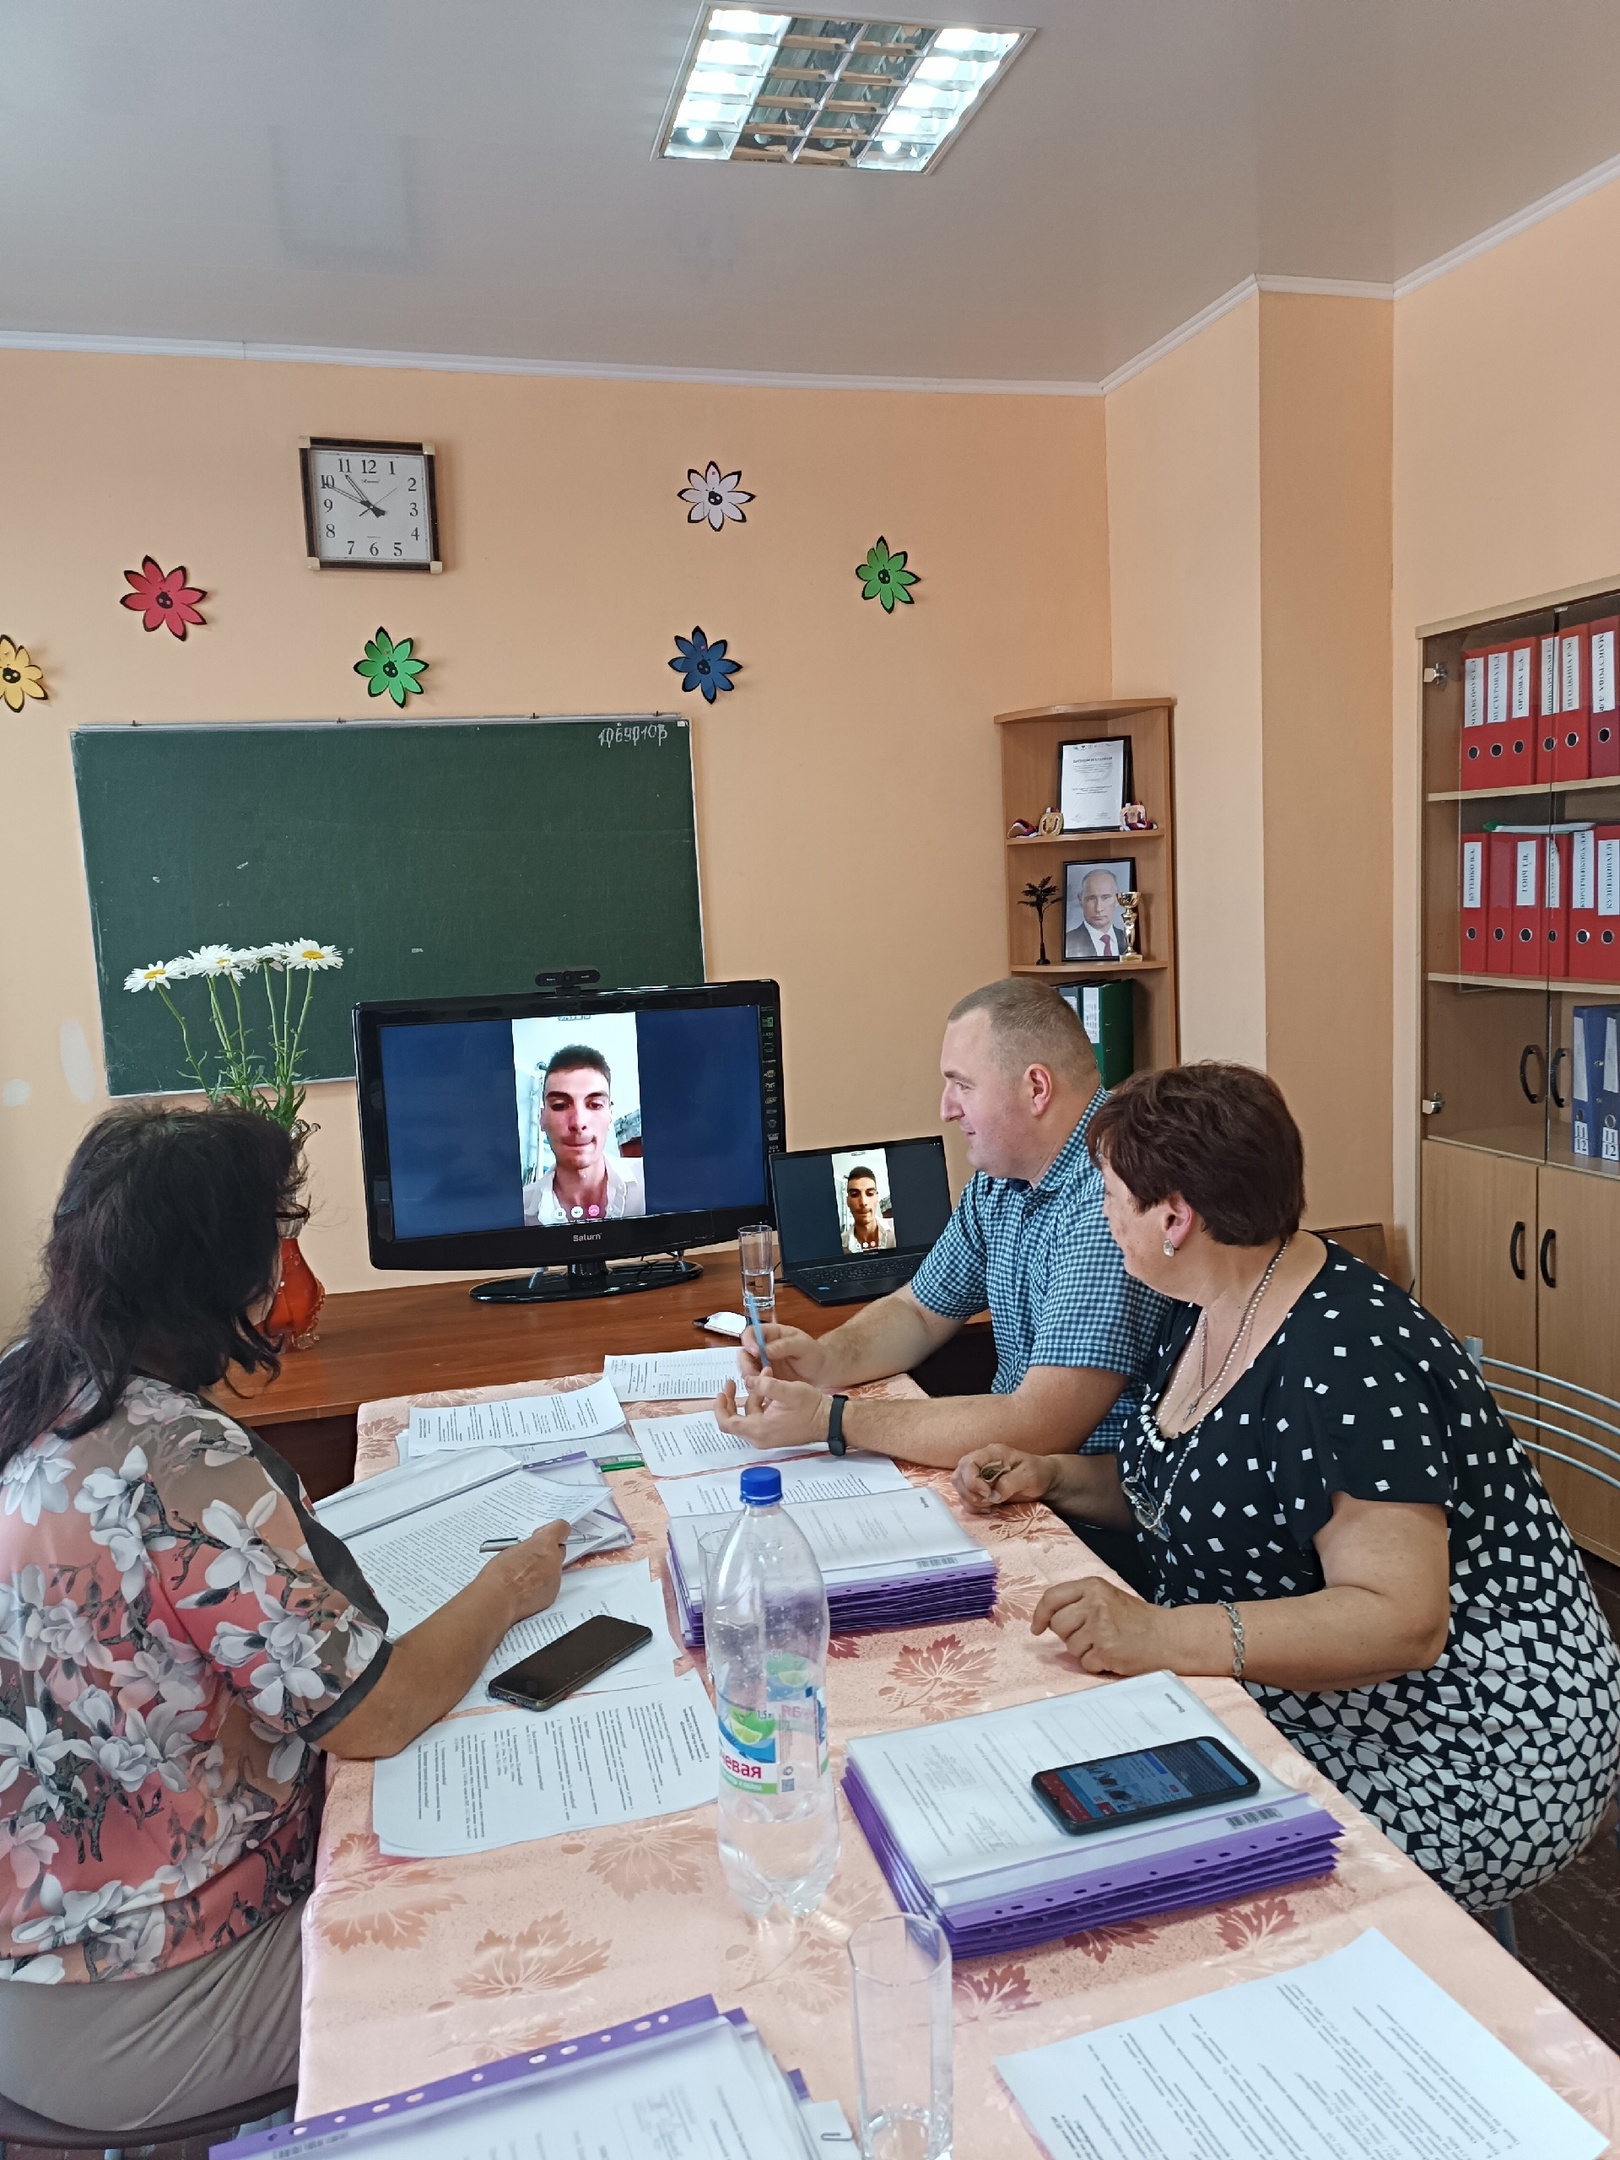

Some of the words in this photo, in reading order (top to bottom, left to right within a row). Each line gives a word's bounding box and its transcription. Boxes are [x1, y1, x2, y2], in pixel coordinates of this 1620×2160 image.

[338, 458, 352, 473] 11
[361, 459, 377, 474] 12
[389, 461, 396, 475] 1
[320, 474, 335, 489] 10
[407, 477, 417, 491] 2
[323, 499, 333, 512] 9
[409, 502, 419, 516] 3
[325, 524, 336, 538] 8
[411, 527, 420, 541] 4
[347, 540, 355, 554] 7
[370, 542, 379, 556] 6
[393, 542, 403, 556] 5
[1605, 1144, 1617, 1156] 12
[572, 1233, 602, 1242] Saturn
[722, 1752, 762, 1779] евая
